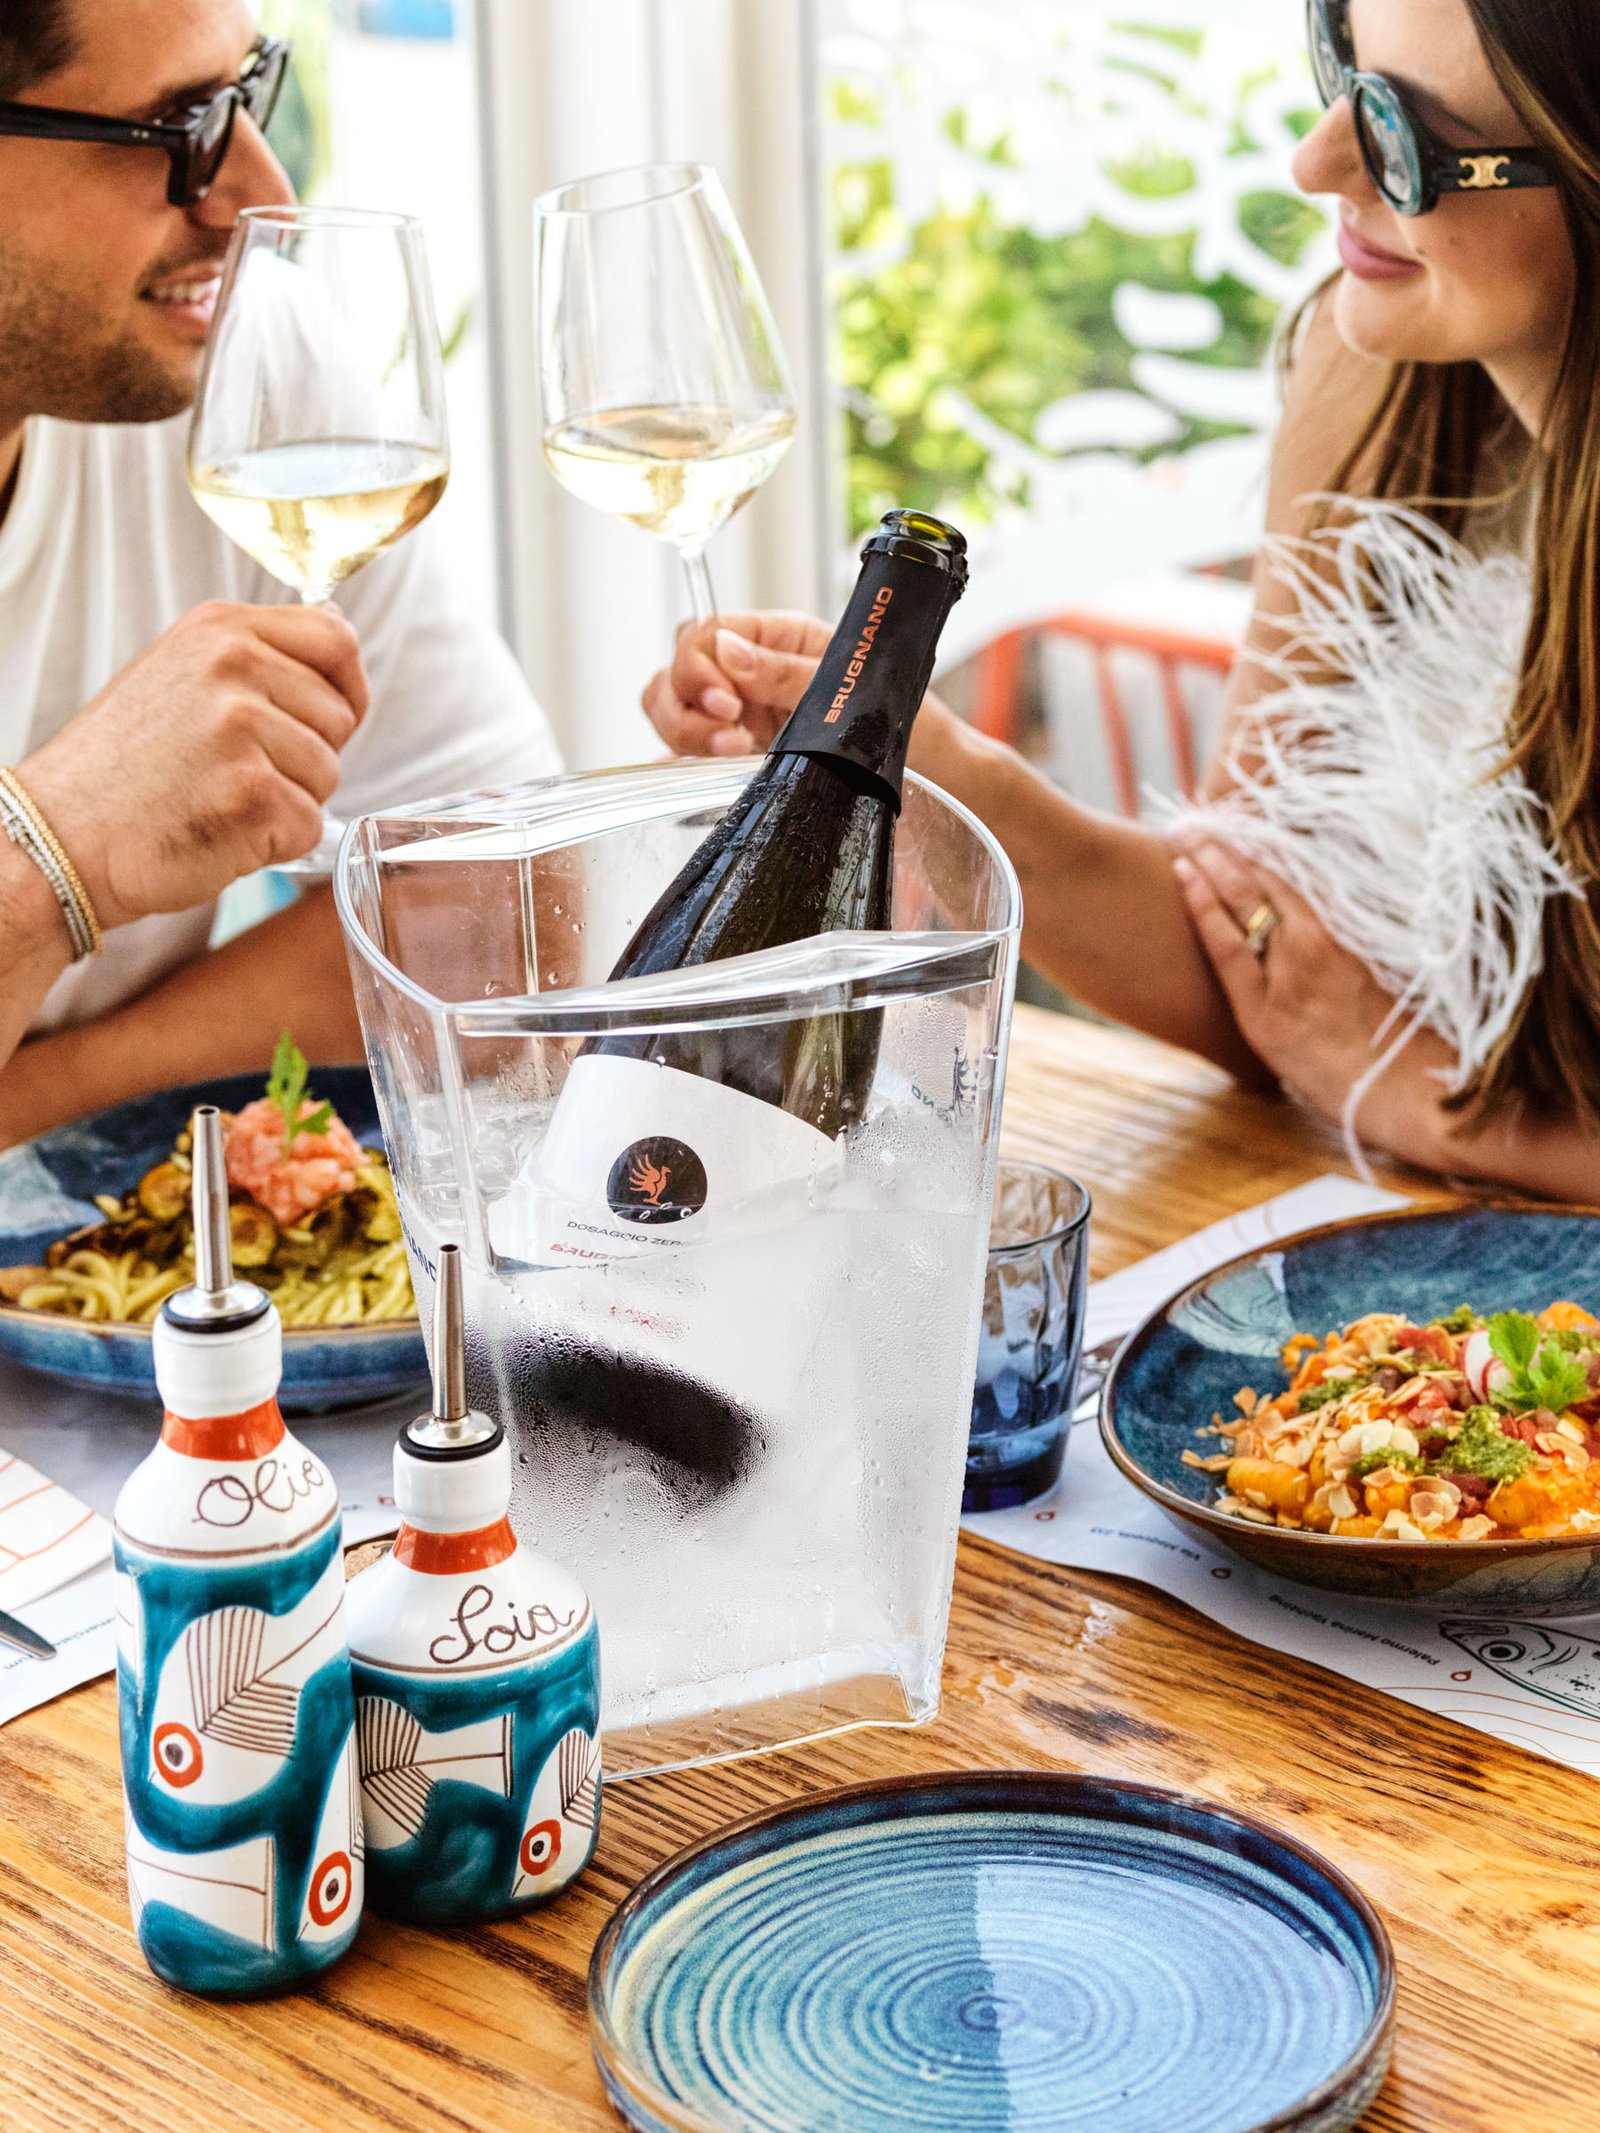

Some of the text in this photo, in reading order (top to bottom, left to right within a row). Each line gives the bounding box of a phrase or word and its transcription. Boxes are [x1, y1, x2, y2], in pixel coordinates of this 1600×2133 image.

[824, 586, 893, 724] BRUGNANO
[191, 1459, 324, 1527] Olio
[429, 1584, 576, 1664] Soia
[1330, 1619, 1380, 1642] Marina
[1381, 1637, 1440, 1666] Palermo
